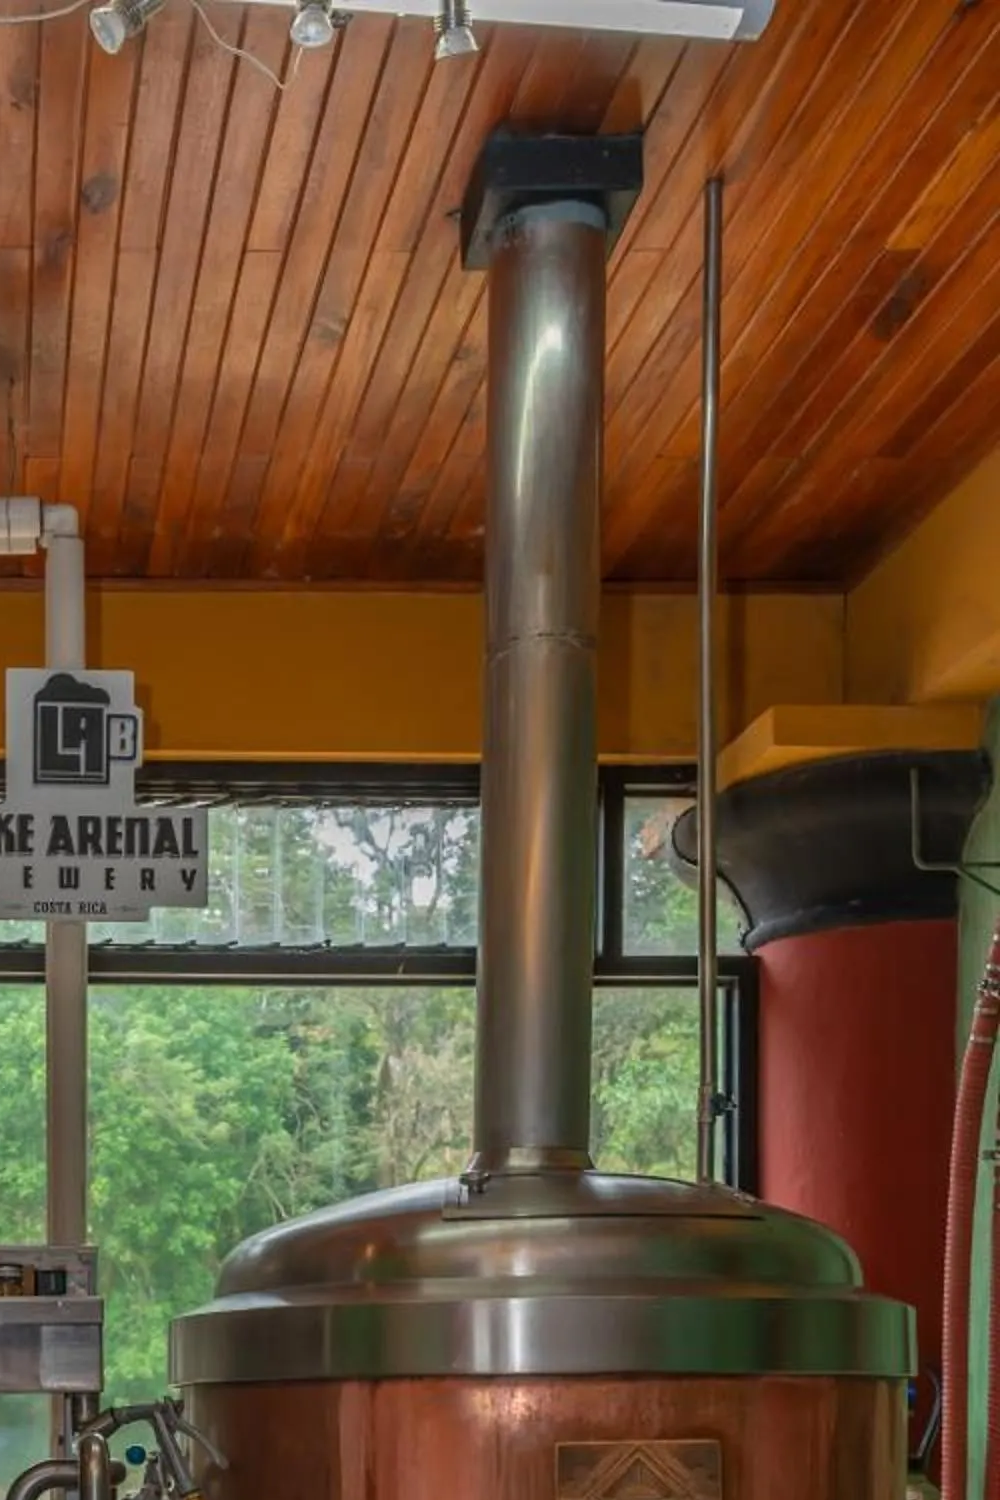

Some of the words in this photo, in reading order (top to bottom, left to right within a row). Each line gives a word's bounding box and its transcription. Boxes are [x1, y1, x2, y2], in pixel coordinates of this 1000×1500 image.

[46, 814, 200, 859] ARENAL
[33, 901, 73, 915] COSTA
[78, 901, 108, 915] RICA
